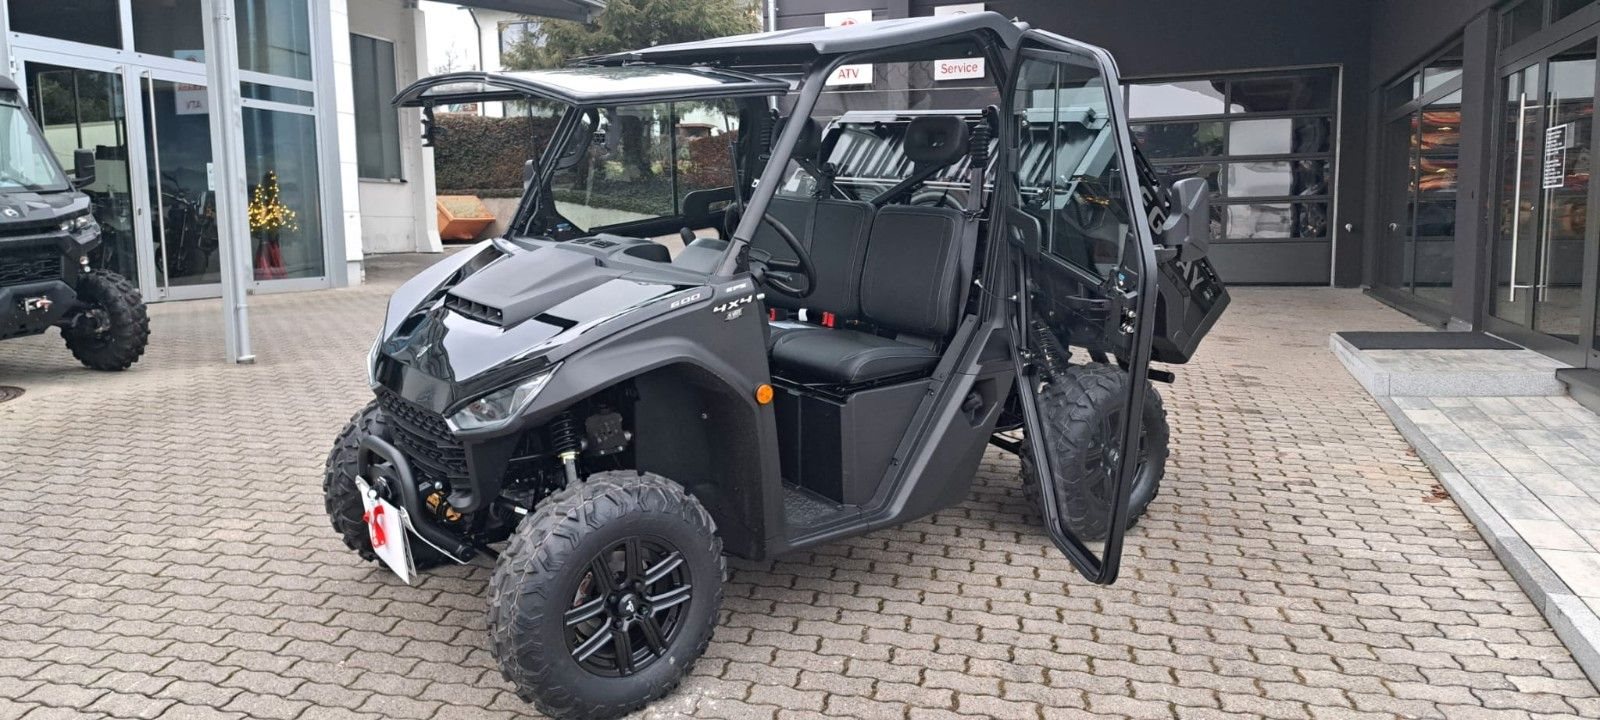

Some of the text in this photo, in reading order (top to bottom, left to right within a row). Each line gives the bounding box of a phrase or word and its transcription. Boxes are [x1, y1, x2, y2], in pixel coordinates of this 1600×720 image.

[838, 68, 859, 79] ATV
[940, 62, 978, 74] Service
[670, 293, 701, 309] 600
